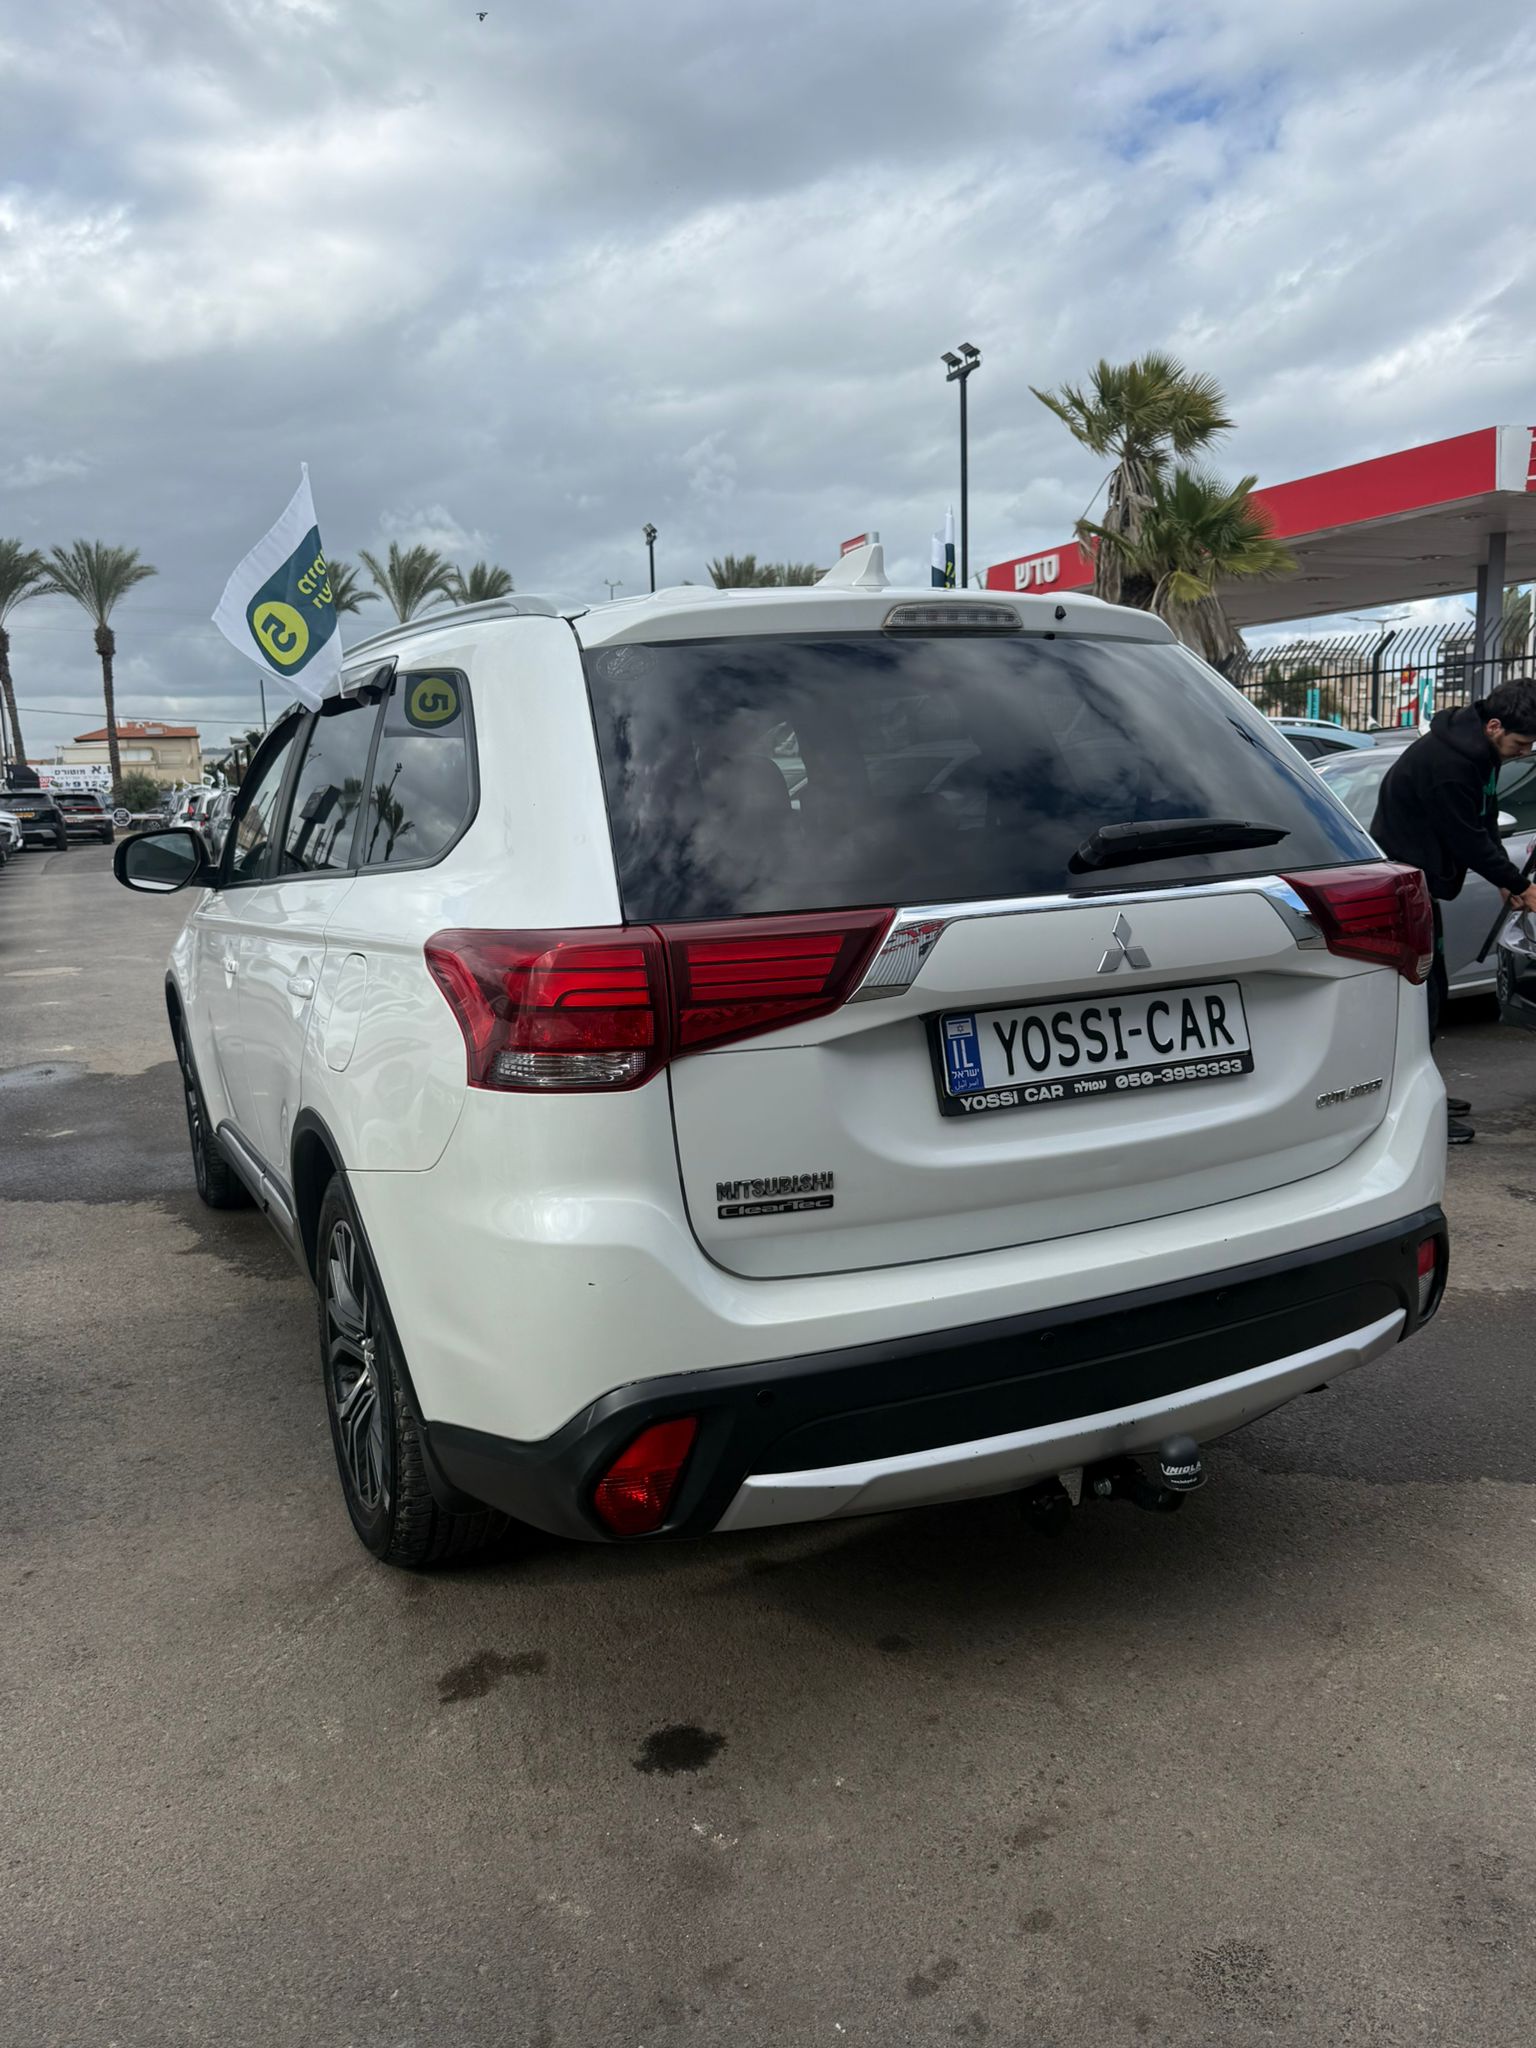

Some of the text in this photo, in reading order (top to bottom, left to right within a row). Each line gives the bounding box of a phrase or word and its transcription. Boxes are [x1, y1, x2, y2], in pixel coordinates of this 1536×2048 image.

[1014, 554, 1059, 590] סדש
[993, 995, 1235, 1076] YOSSI-CAR
[952, 1039, 974, 1069] IL
[951, 1069, 980, 1079] ישראל
[960, 1059, 1243, 1111] YOSSI CAR עפולה 050-3953333
[716, 1171, 834, 1201] MITSUBISHI
[720, 1199, 832, 1216] ClearTec
